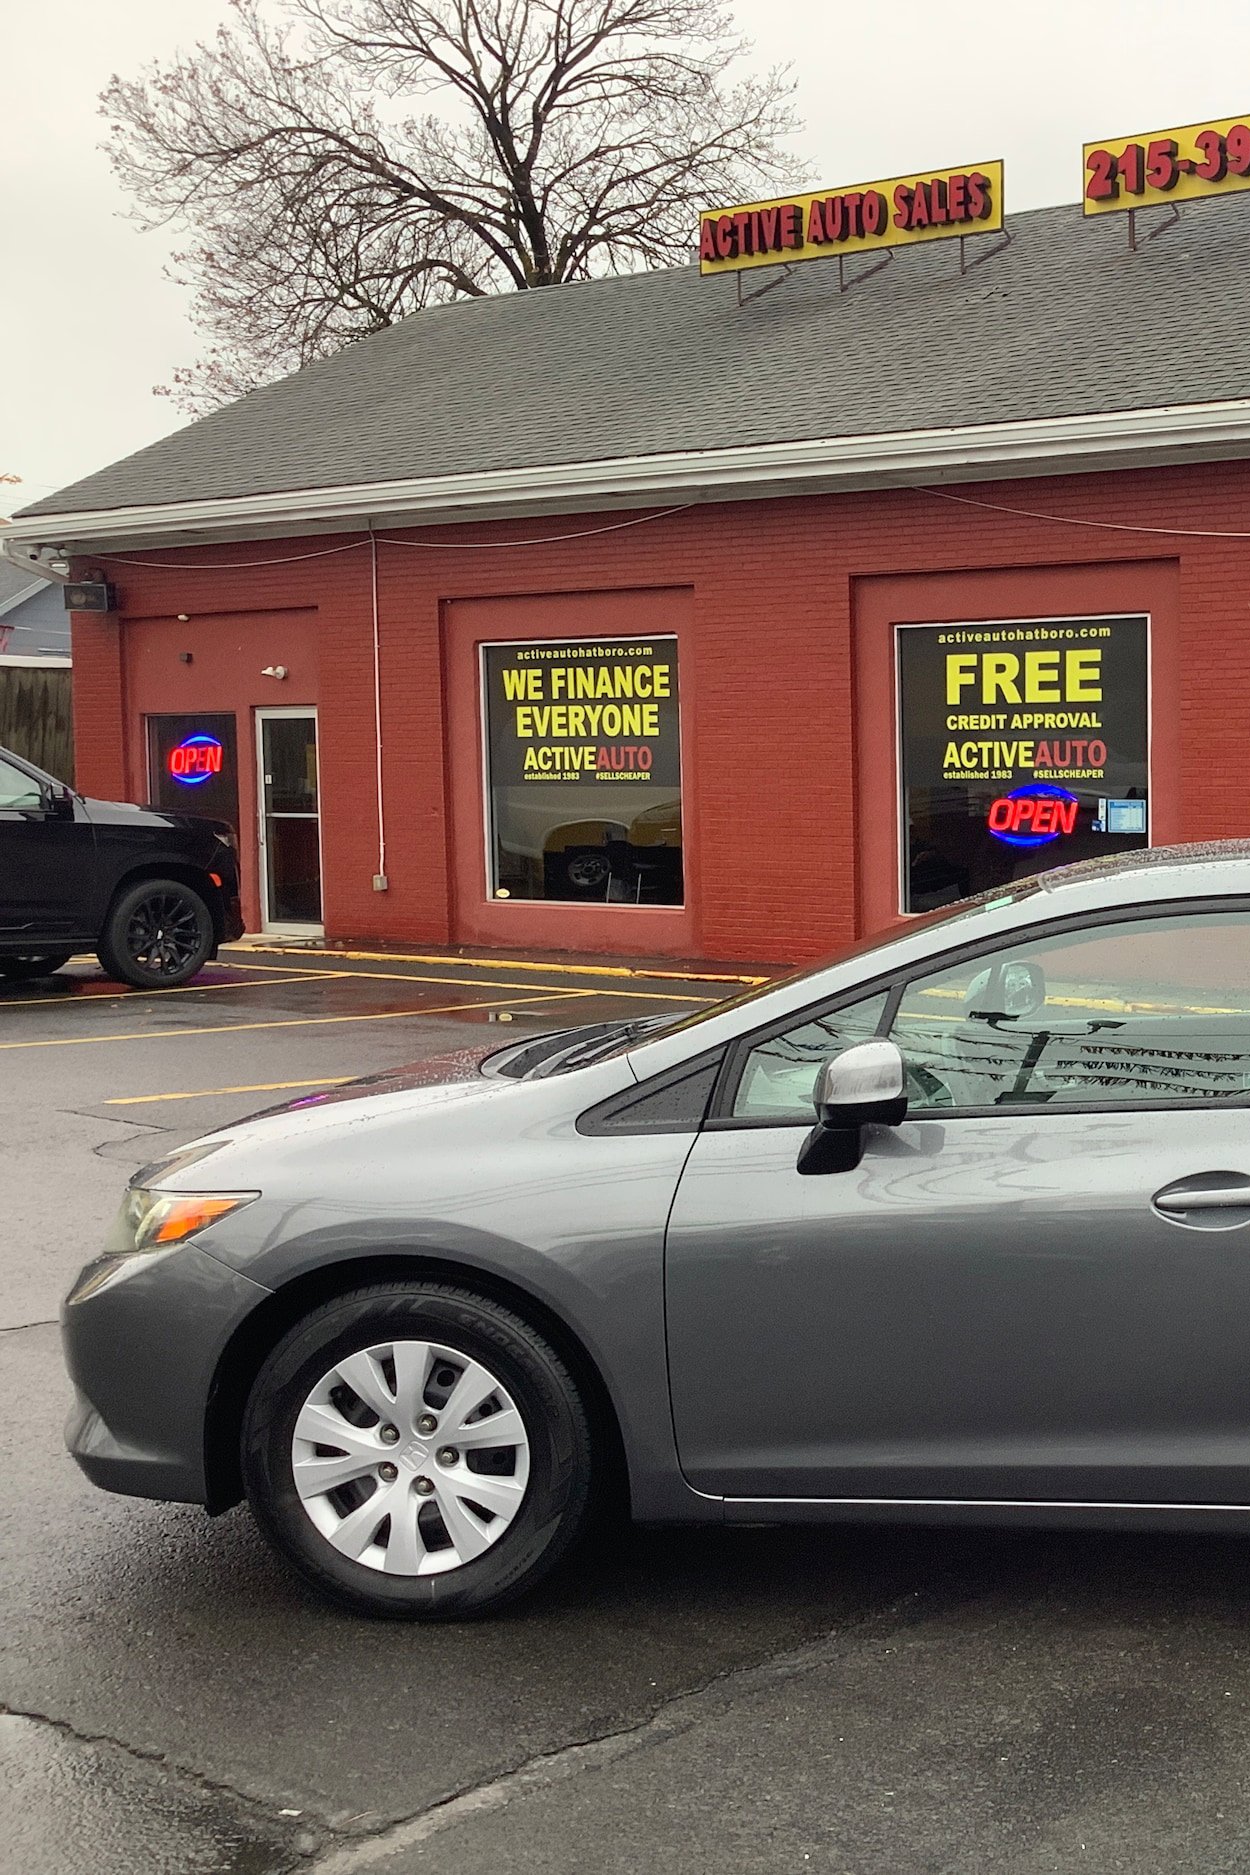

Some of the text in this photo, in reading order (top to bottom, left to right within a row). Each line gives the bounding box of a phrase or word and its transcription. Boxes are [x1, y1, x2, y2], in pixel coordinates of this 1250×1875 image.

[700, 172, 992, 262] ACTIVE AUTO SALES
[938, 627, 1111, 644] activeautohatboro.com
[517, 647, 653, 660] activeautohatboro.com
[502, 665, 671, 701] WE FINANCE
[946, 649, 1102, 705] FREE
[516, 704, 660, 738] EVERYONE
[946, 712, 1102, 730] CREDIT APPROVAL
[170, 746, 223, 774] OPEN
[943, 769, 1104, 779] established 1983 #SELLSCHEAPER
[988, 797, 1079, 834] OPEN
